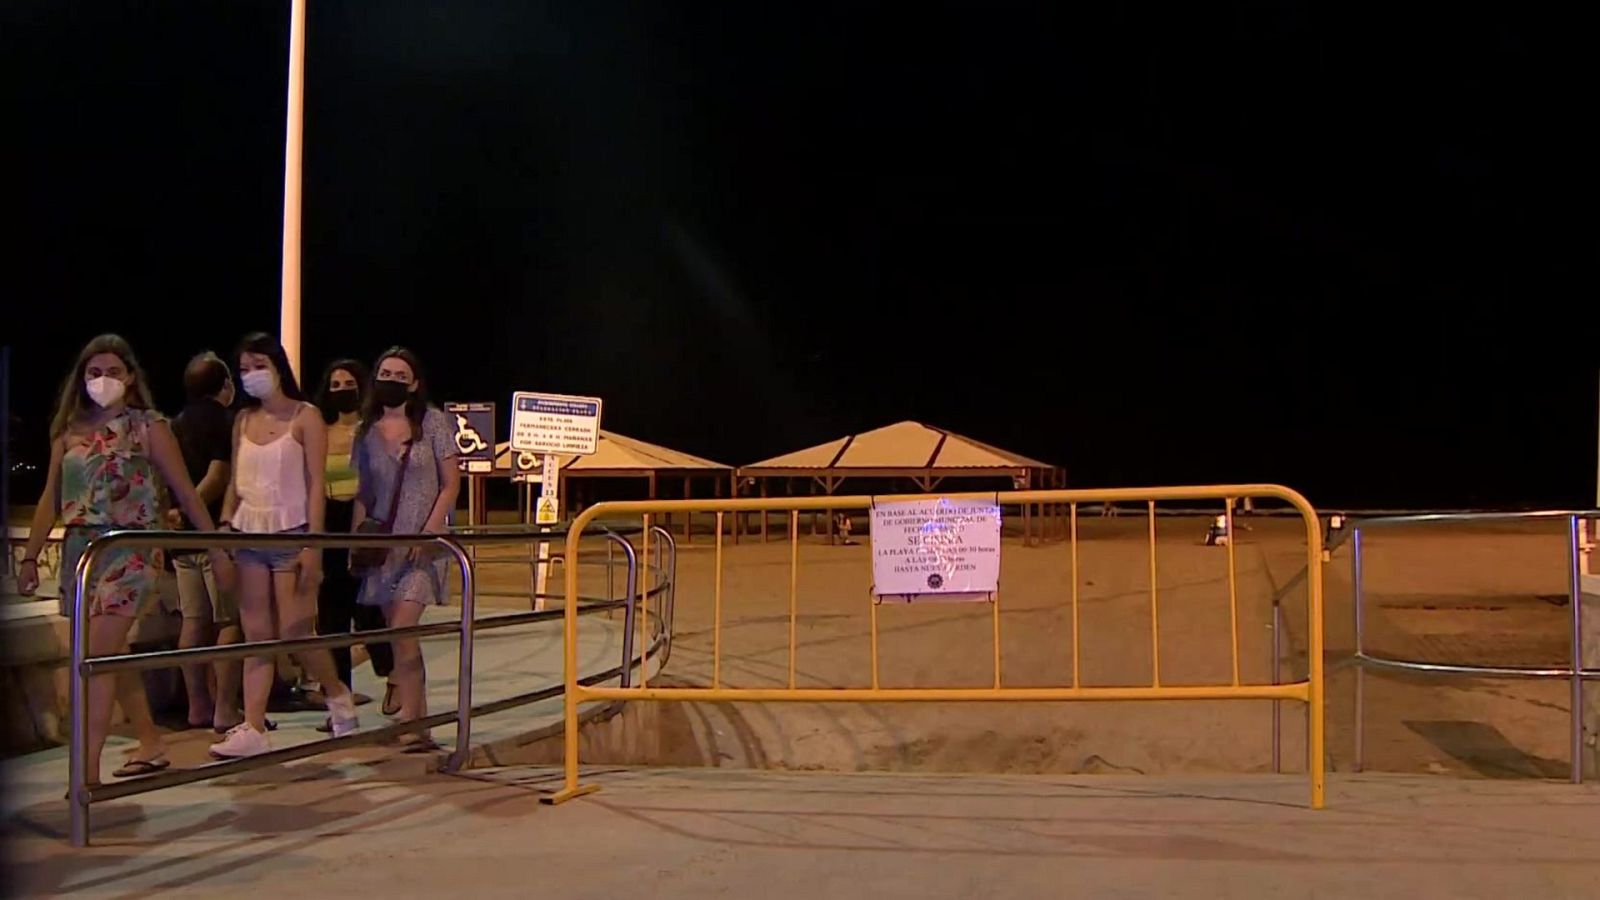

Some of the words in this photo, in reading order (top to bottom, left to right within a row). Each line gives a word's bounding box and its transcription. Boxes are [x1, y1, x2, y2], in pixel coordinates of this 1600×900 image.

[908, 536, 921, 545] SE
[878, 549, 888, 557] LA
[889, 548, 914, 556] PLAYA
